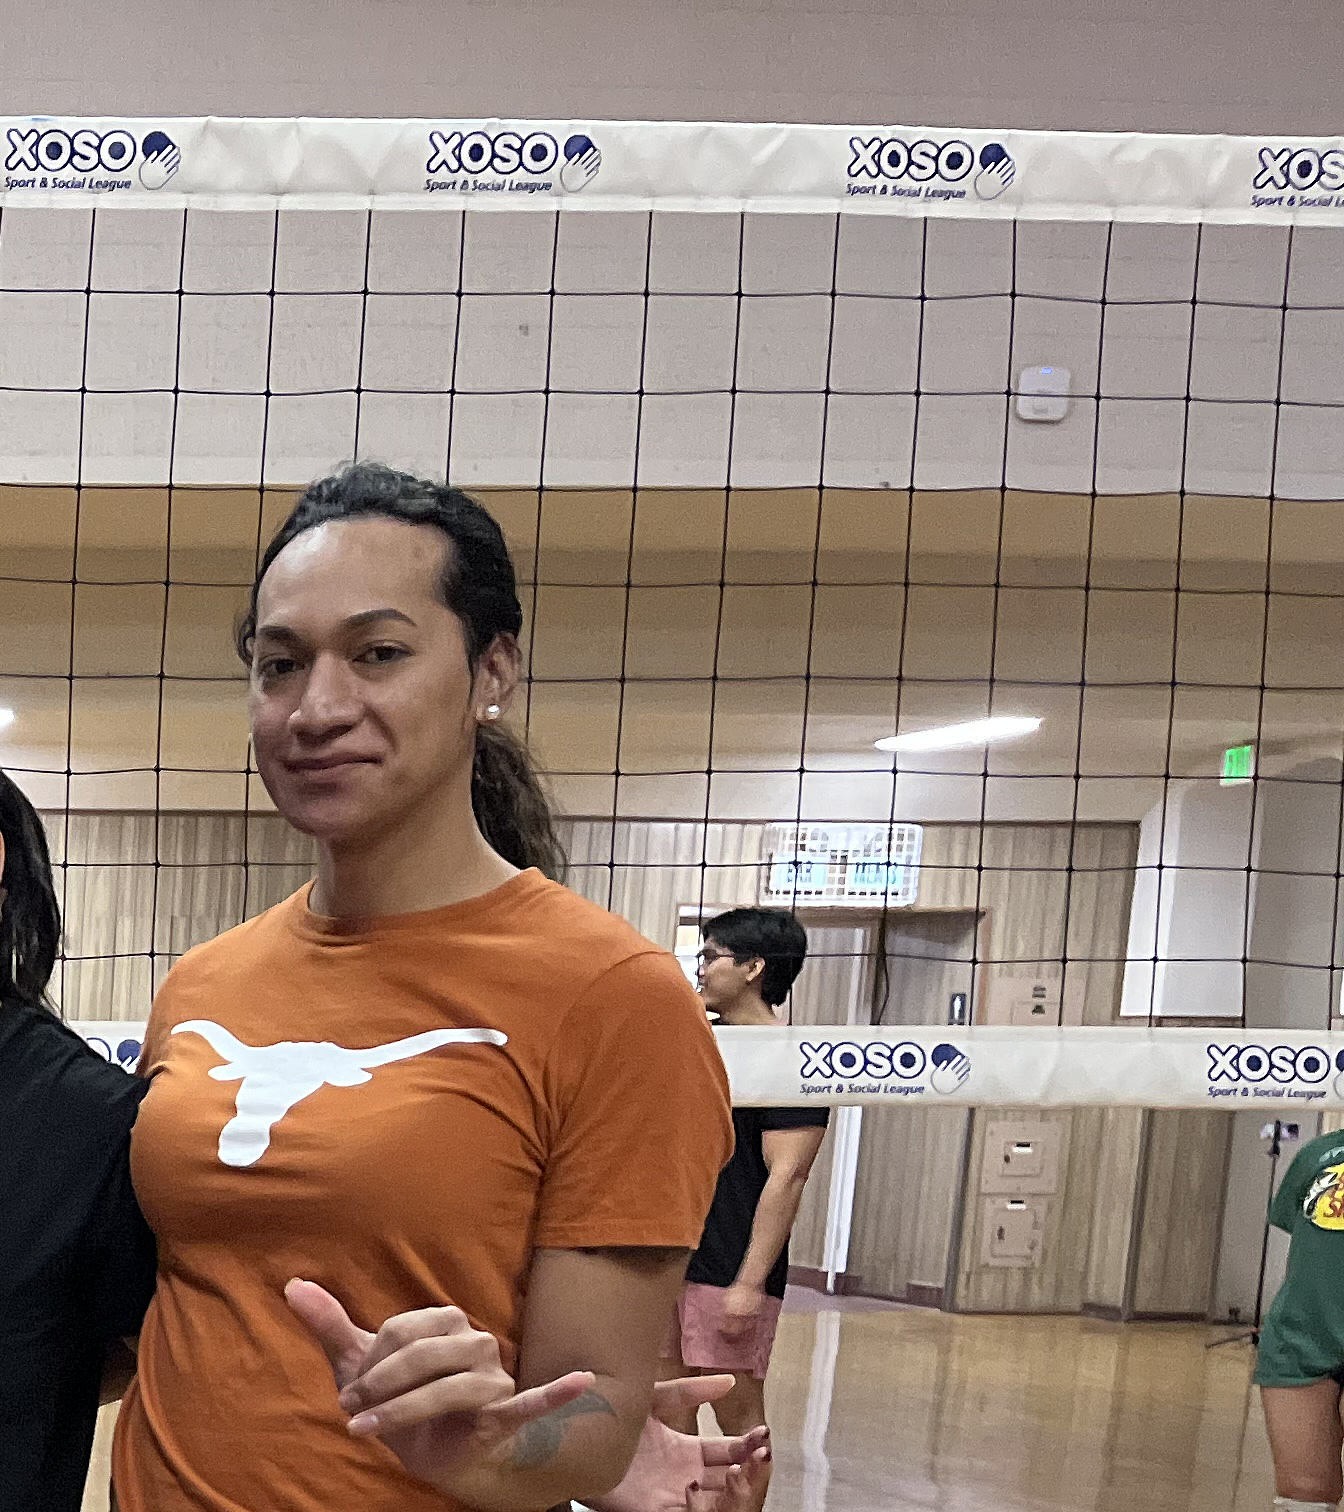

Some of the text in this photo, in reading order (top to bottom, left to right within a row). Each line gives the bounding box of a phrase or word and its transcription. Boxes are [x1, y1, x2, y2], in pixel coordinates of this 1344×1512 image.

[5, 128, 137, 173] XOSO
[426, 131, 558, 175] XOSO
[847, 136, 975, 182] XOSO
[4, 176, 37, 191] Sport
[51, 177, 86, 189] Social
[88, 177, 132, 192] League
[423, 179, 456, 192] Sport
[472, 179, 506, 191] Social
[508, 179, 553, 194] League
[845, 183, 877, 197] Sport
[891, 185, 922, 198] Social
[924, 186, 967, 201] League
[799, 1041, 927, 1079] XOSO
[1207, 1044, 1331, 1083] XOSO
[800, 1083, 832, 1096] Sport
[848, 1083, 881, 1095] Social
[883, 1084, 925, 1096] League
[1207, 1086, 1238, 1098] Sport
[1253, 1086, 1285, 1098] Social
[1287, 1088, 1327, 1101] League
